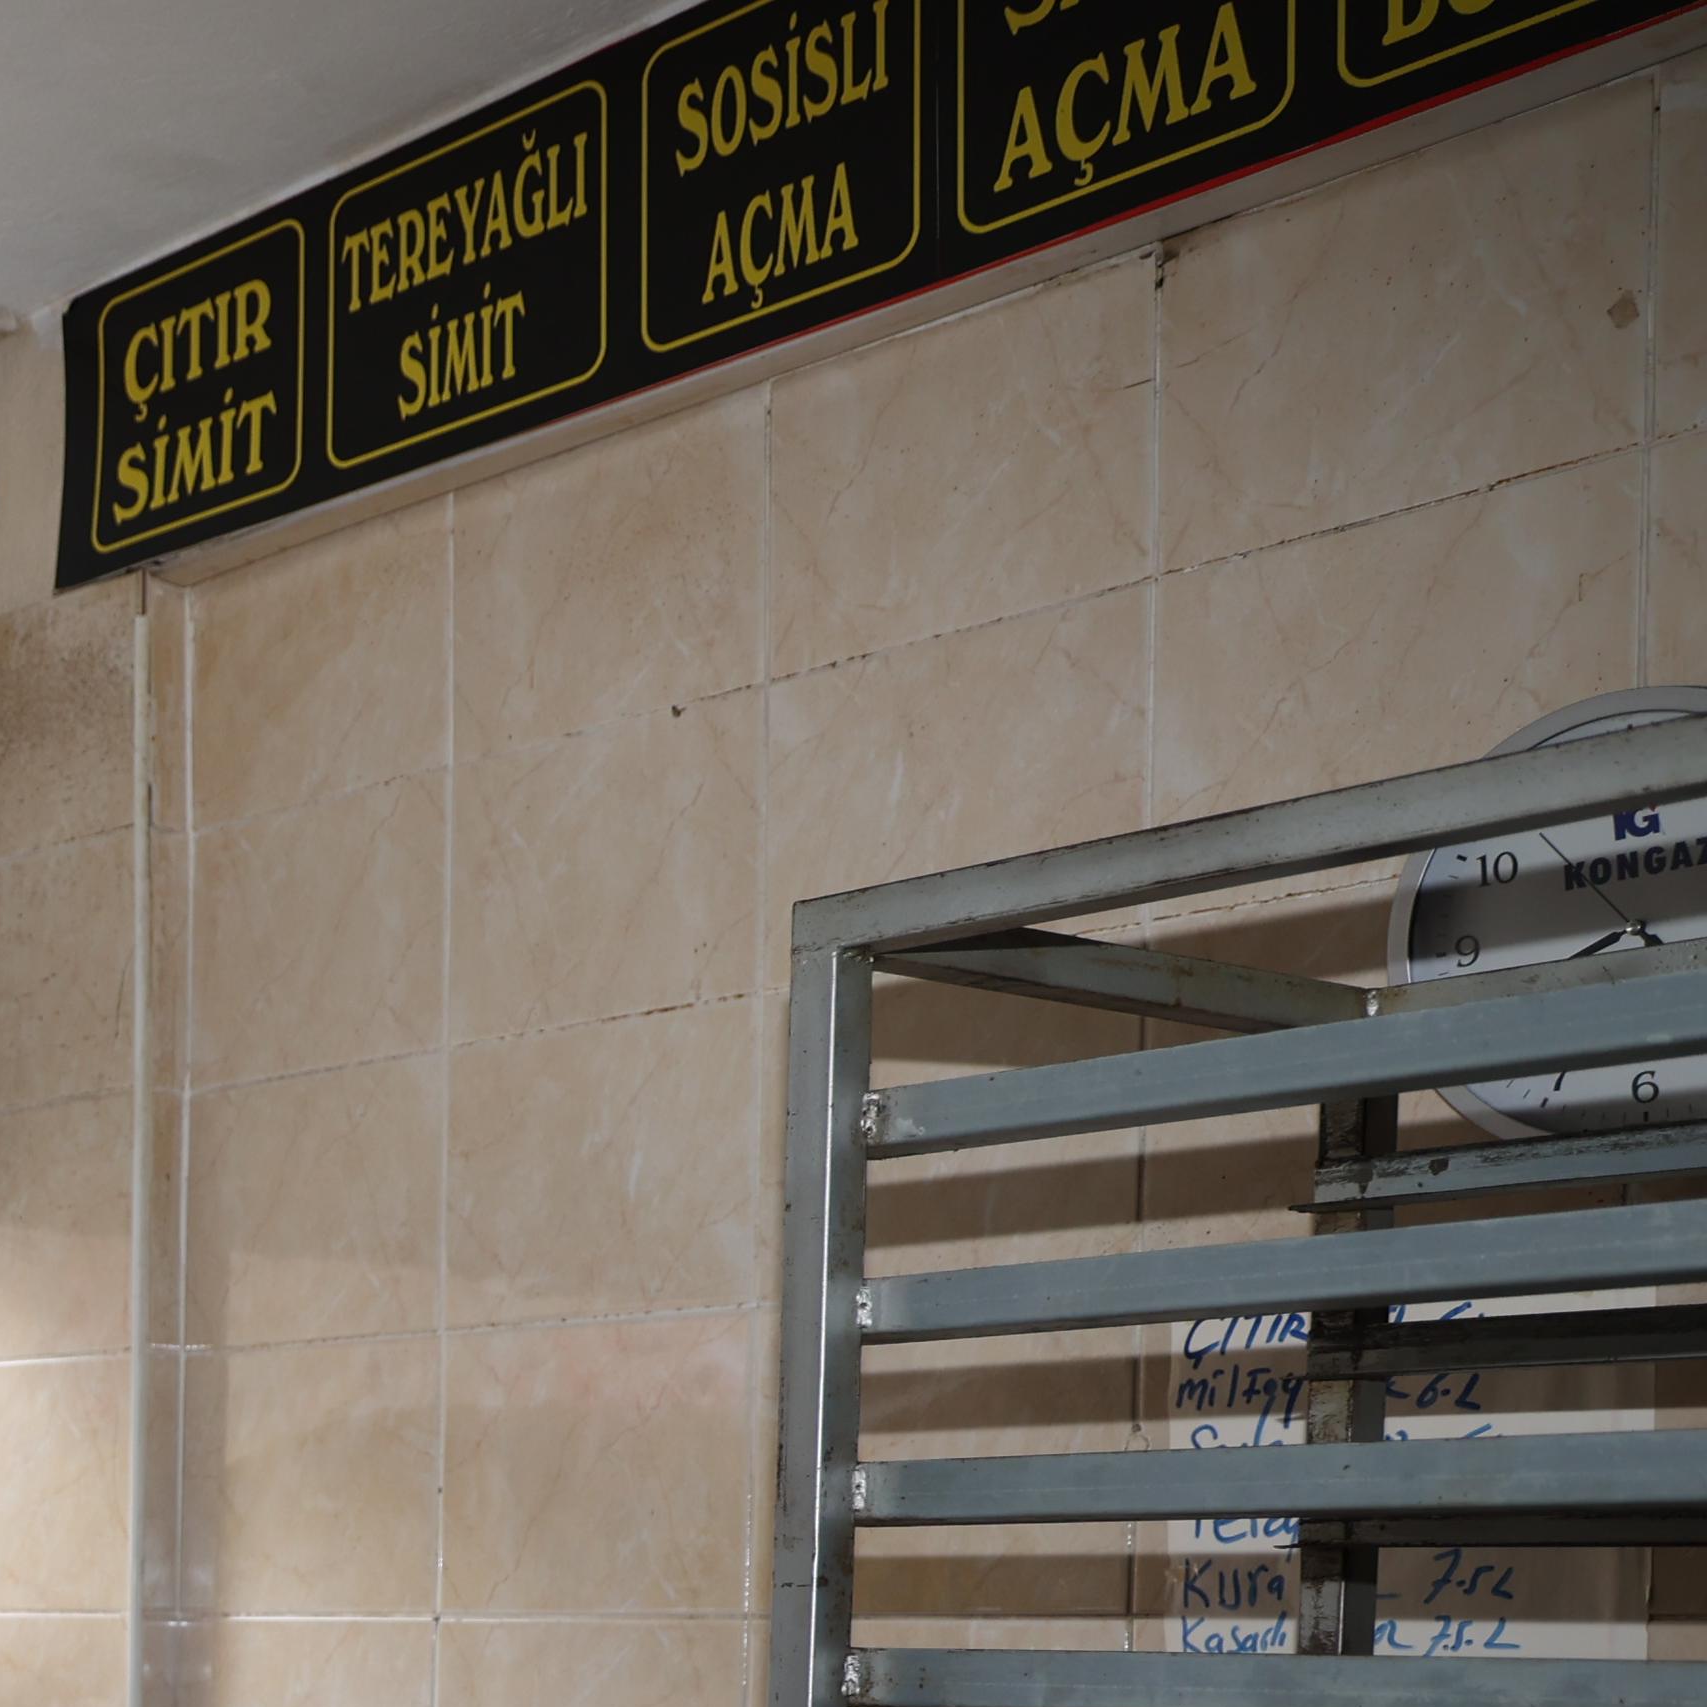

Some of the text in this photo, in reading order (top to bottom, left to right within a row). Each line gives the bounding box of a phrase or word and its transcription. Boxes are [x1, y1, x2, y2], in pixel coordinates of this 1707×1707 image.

[993, 2, 1257, 192] AÇMA
[341, 129, 588, 313] TEREYAĞLI
[702, 162, 859, 309] AÇMA
[124, 279, 272, 423] ÇITIR
[398, 283, 525, 420] SİMİT
[112, 388, 277, 525] SİMİT
[1476, 851, 1518, 888] 10
[1455, 935, 1480, 968] 9
[1632, 1070, 1659, 1104] 6
